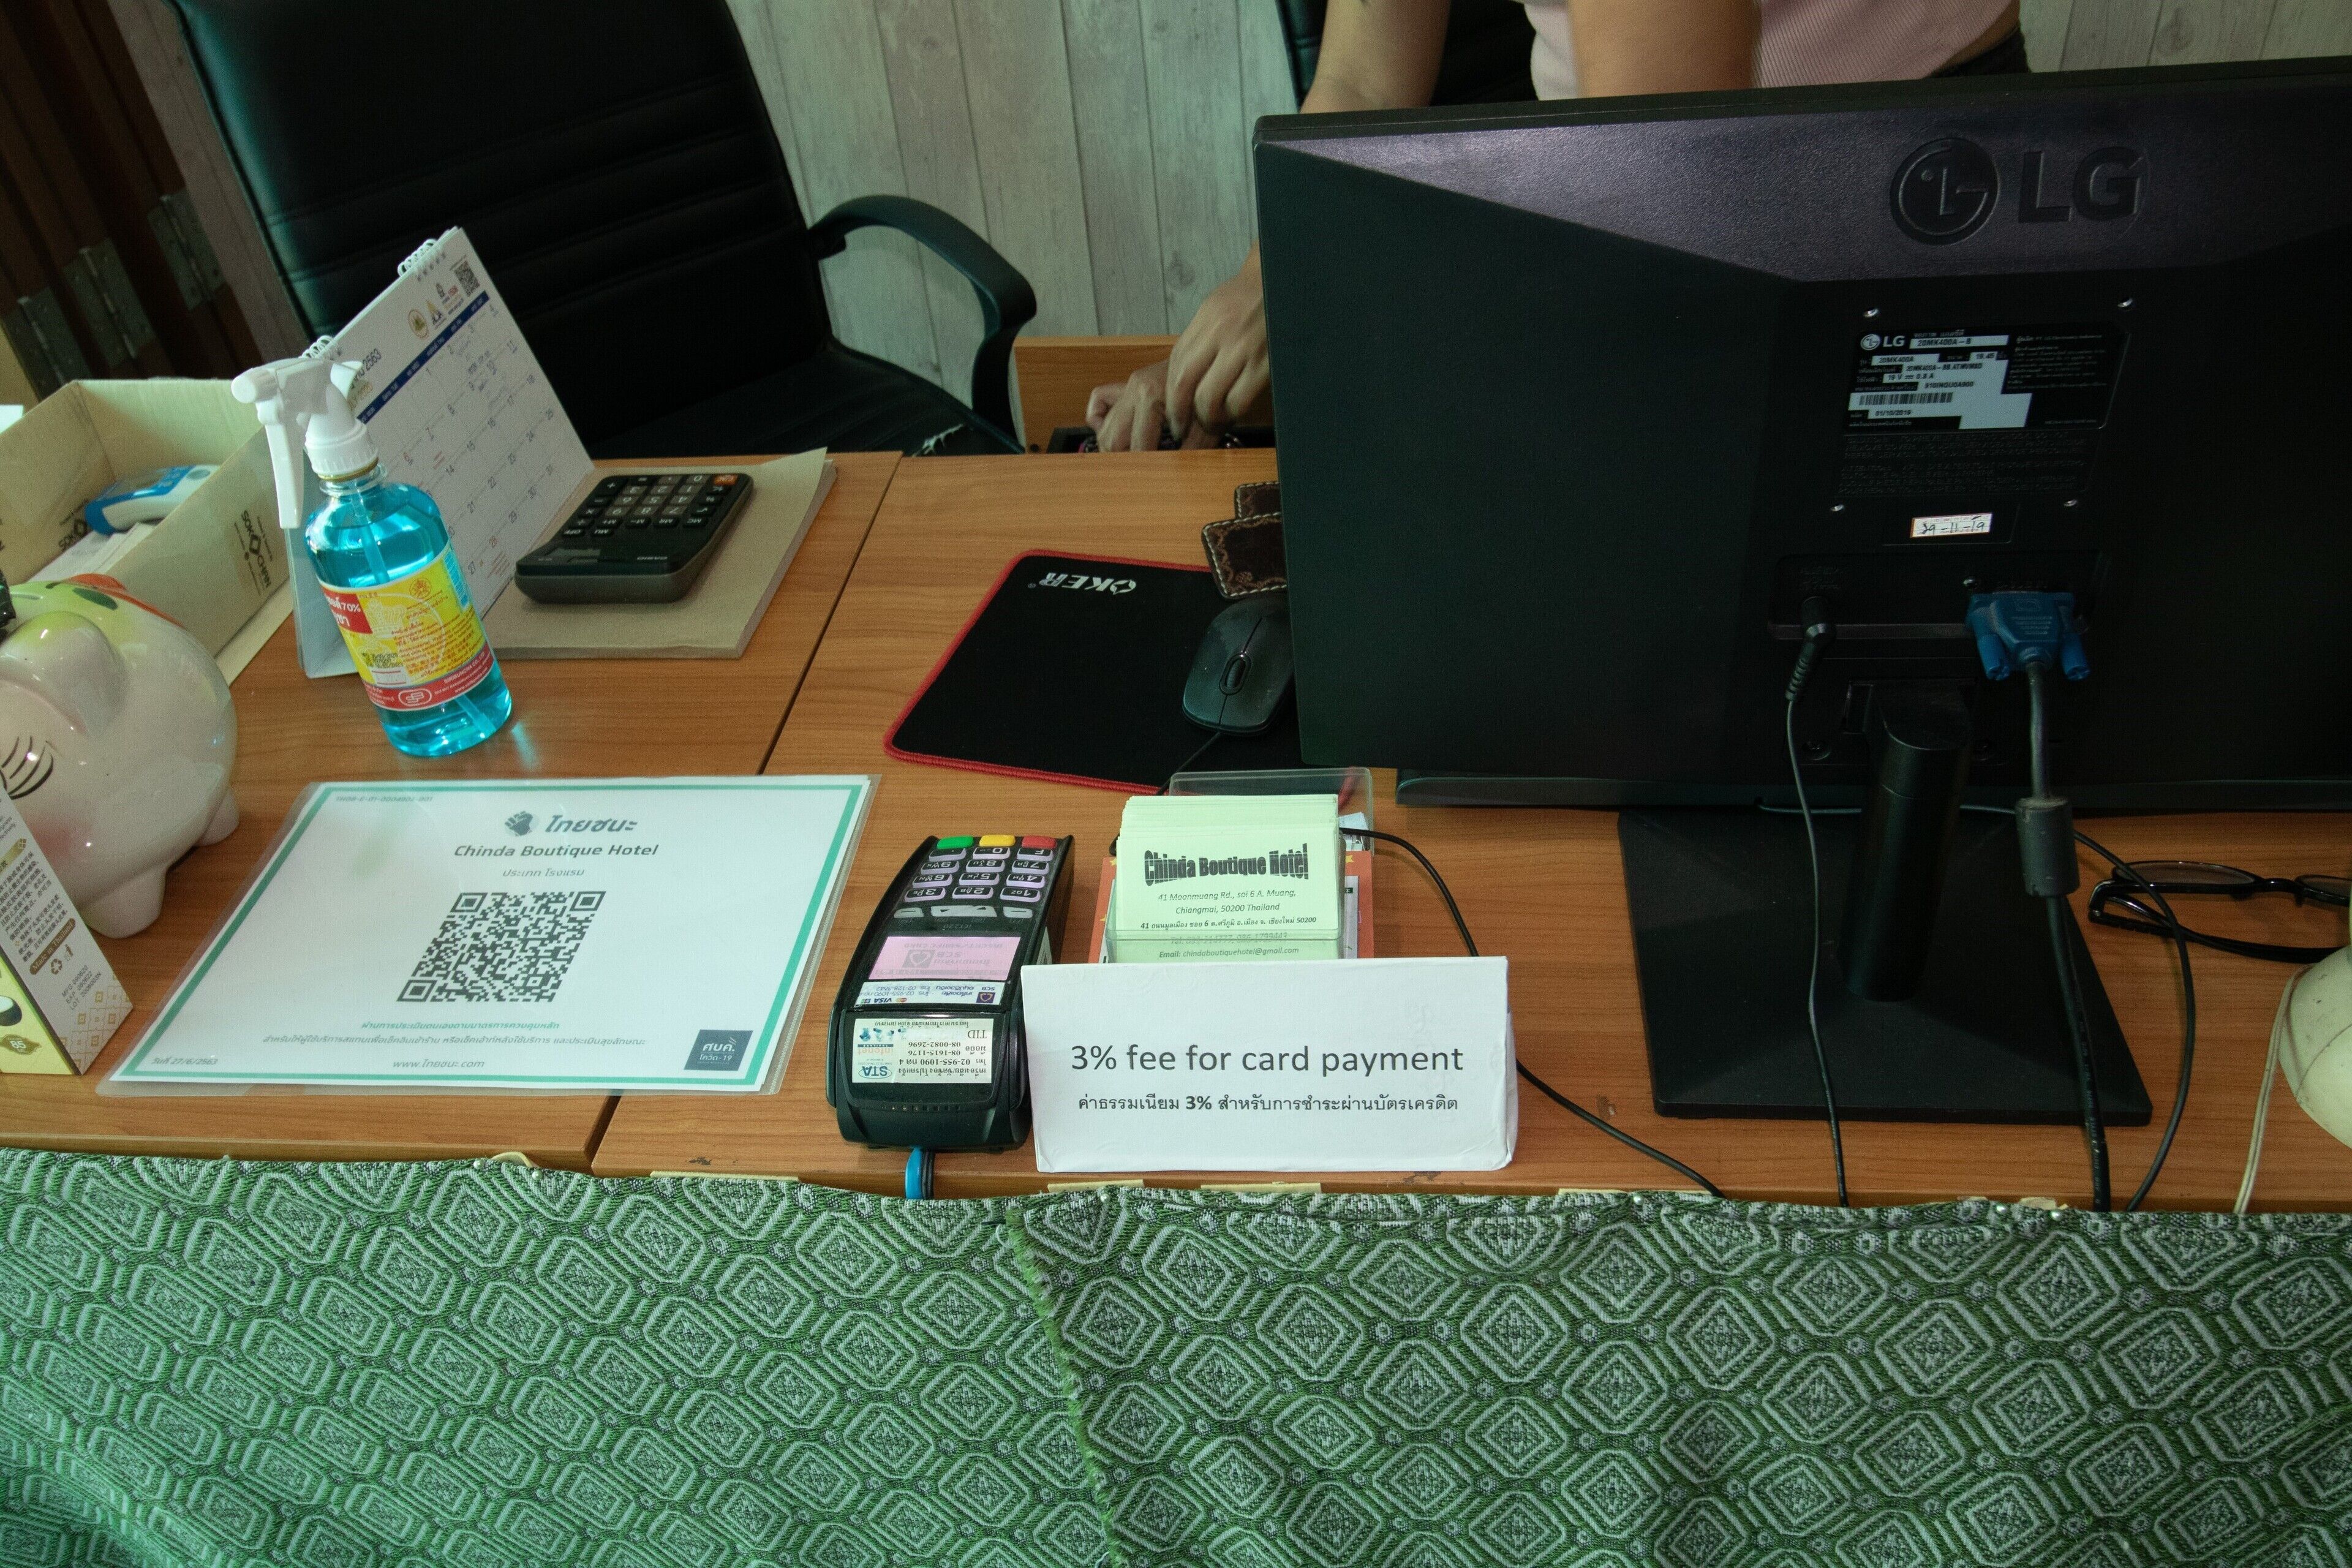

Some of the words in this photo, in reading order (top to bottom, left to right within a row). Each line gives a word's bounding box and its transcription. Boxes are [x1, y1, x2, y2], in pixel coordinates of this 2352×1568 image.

[2018, 146, 2149, 222] LG
[1883, 336, 1905, 347] LG
[1039, 572, 1137, 595] OKER
[545, 815, 638, 833] ไทยชนะ
[454, 845, 516, 856] Chinda
[520, 845, 603, 858] Boutique
[608, 844, 660, 856] Hotel
[1144, 850, 1197, 886] Chinda
[1199, 856, 1267, 876] Boutique
[1269, 843, 1310, 880] Hotel
[545, 868, 586, 877] โรงแรม
[1169, 892, 1219, 901] Moonmuang
[1267, 889, 1297, 898] Muang,
[1175, 905, 1219, 916] Chiangmai,
[1247, 903, 1280, 912] Thailand
[1268, 916, 1295, 925] เชียงใหม่
[32, 955, 48, 970] Made
[53, 921, 75, 947] Thailand
[1183, 948, 1300, 957] chindaboutiquehotel@gmail.com
[62, 984, 74, 997] MFG
[66, 991, 76, 1004] EXP
[70, 998, 80, 1010] LOT
[967, 1030, 987, 1039] TID
[10, 1040, 26, 1049] 85
[702, 1042, 736, 1052] ศบค.
[965, 1045, 987, 1055] มือถือ
[393, 1058, 484, 1068] www.ไทยชนะ.com
[1072, 1045, 1117, 1070] 3%
[1126, 1044, 1176, 1071] fee
[1186, 1044, 1232, 1071] for
[1242, 1046, 1309, 1071] card
[1322, 1048, 1464, 1077] payment
[861, 1065, 889, 1077] STA
[1079, 1093, 1179, 1110] ค่าธรรมเนียม
[1186, 1096, 1212, 1110] 3%
[1218, 1094, 1458, 1110] สำหรับการชำระผ่านบัตรเครดิต
